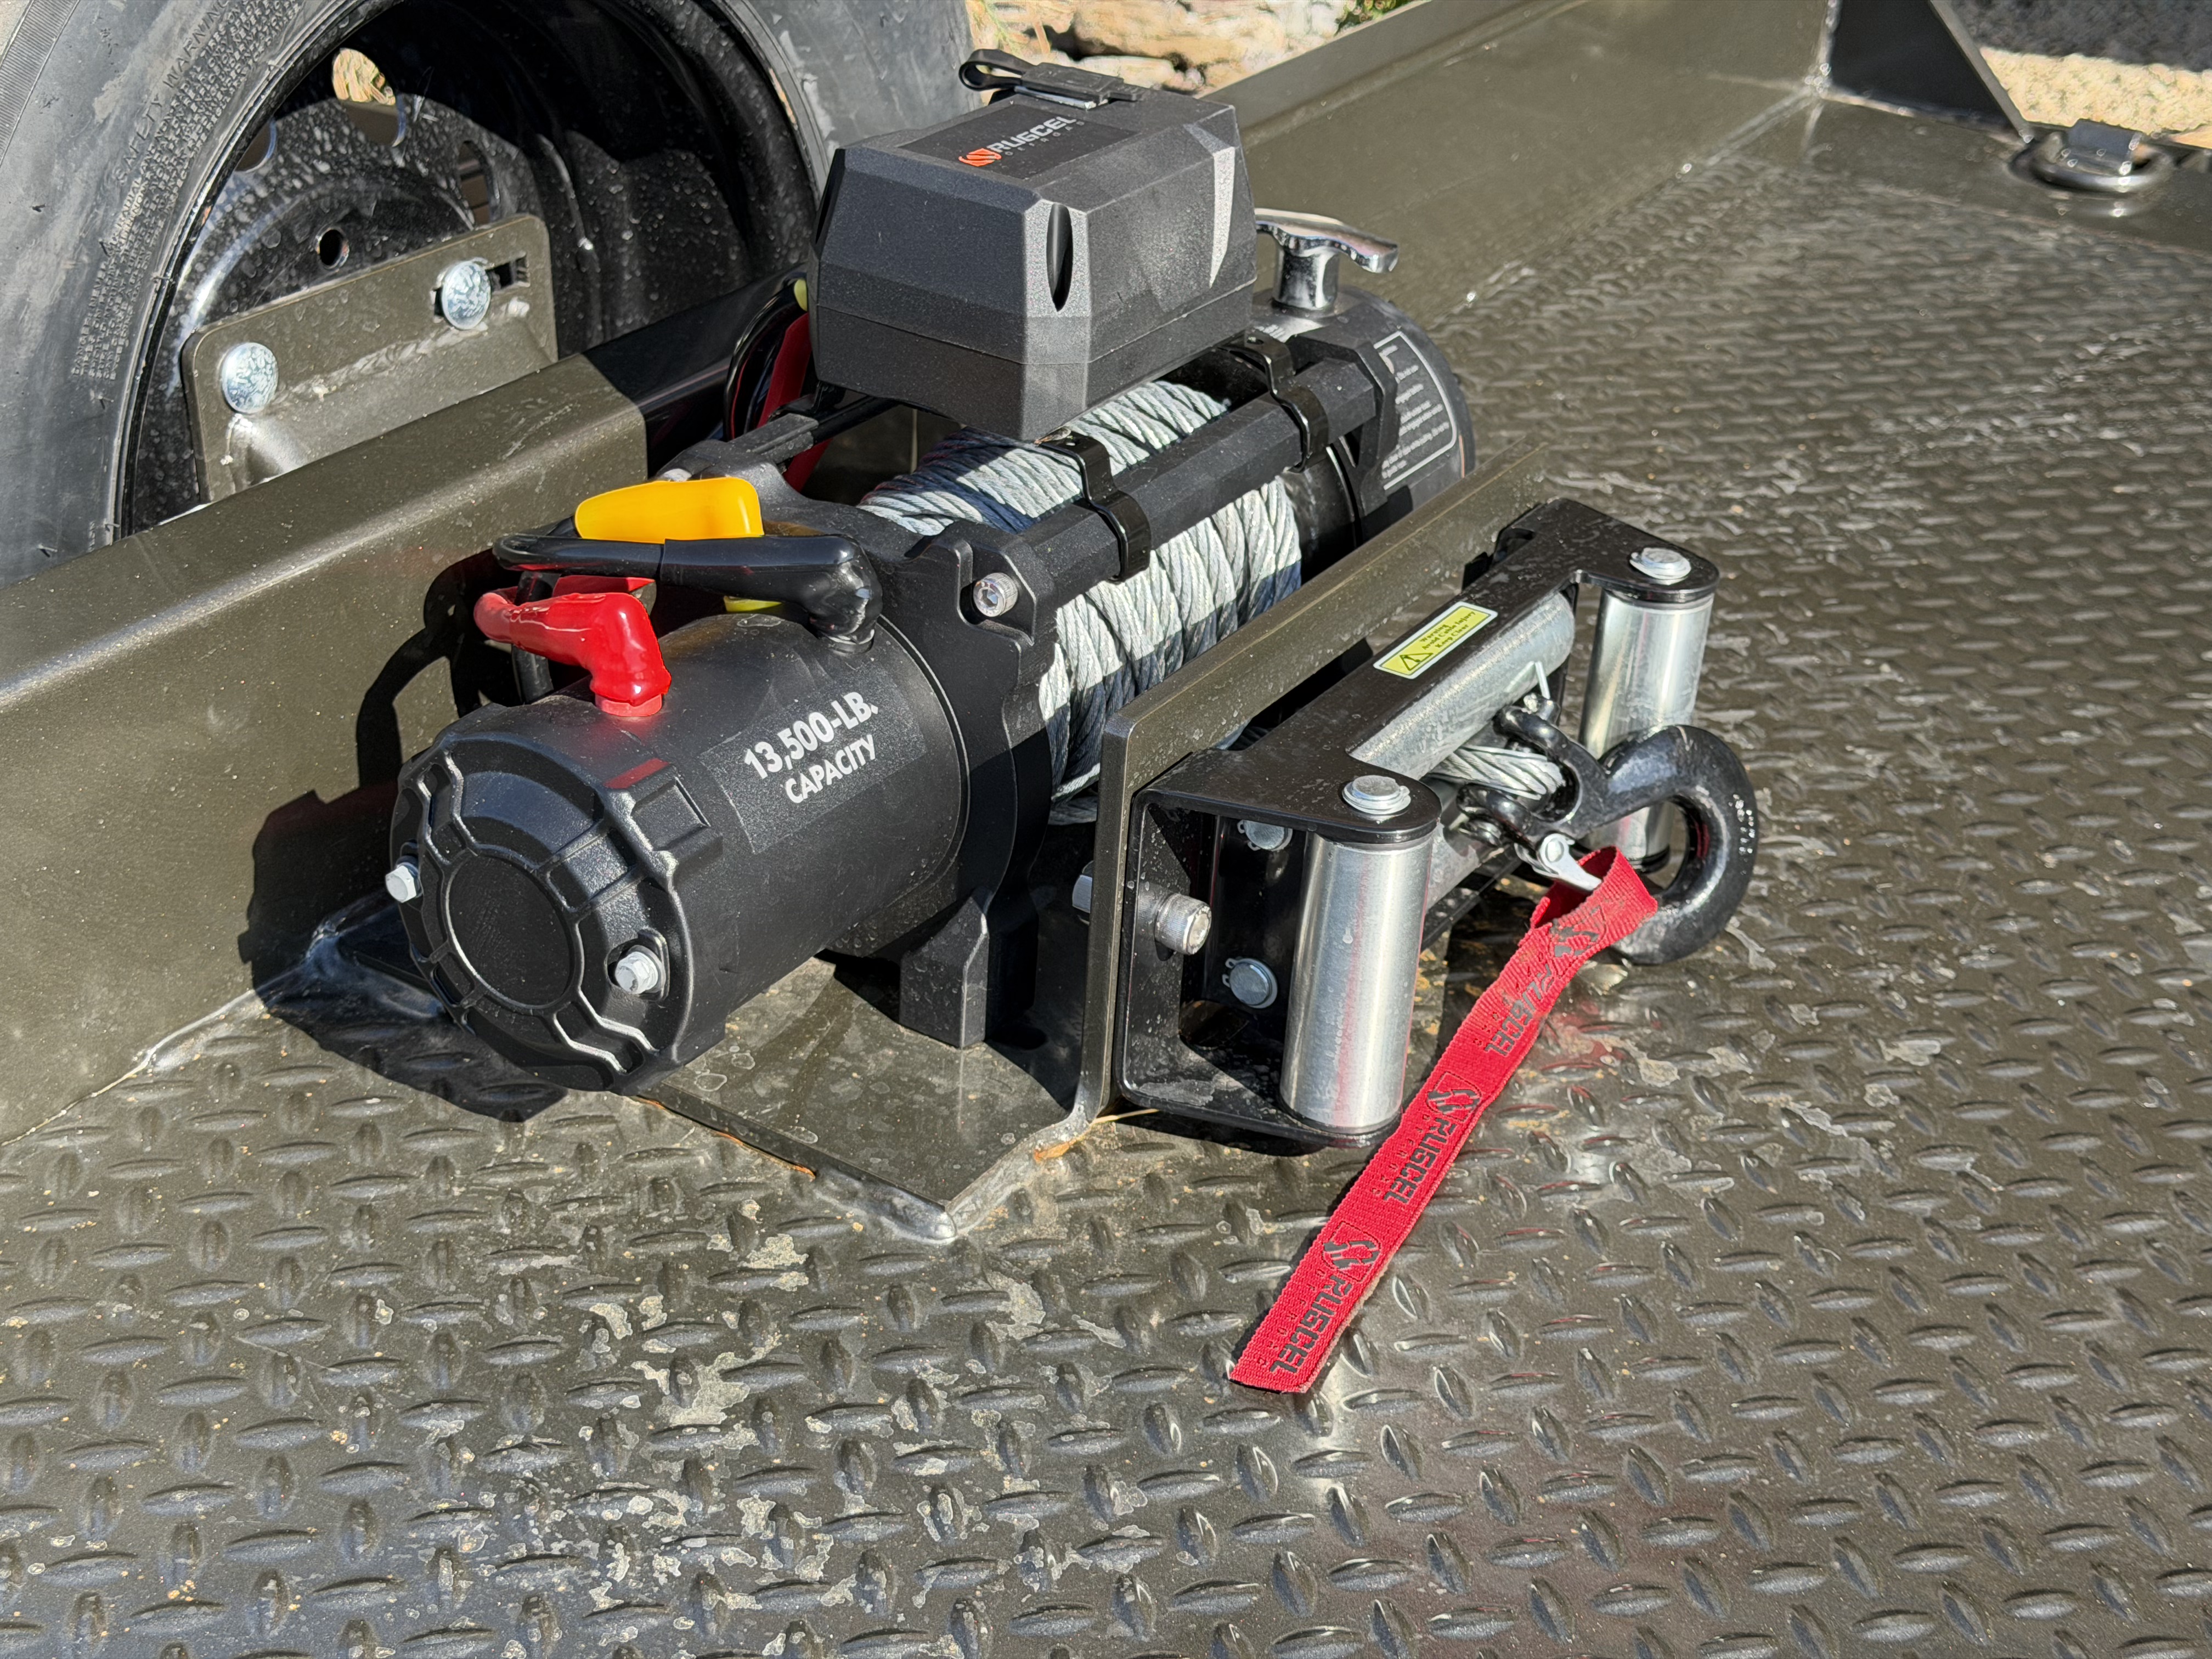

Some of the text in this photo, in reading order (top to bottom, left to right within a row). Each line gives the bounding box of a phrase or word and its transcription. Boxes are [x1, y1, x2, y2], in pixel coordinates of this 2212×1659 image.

[87, 260, 109, 308] NEVER
[114, 174, 141, 229] RADIAL
[136, 142, 156, 174] AND
[224, 5, 241, 24] ON
[91, 308, 103, 329] ON
[98, 257, 119, 304] FRONT
[170, 106, 187, 128] ON
[228, 0, 260, 36] SPECI
[103, 268, 123, 319] MOUNT
[137, 196, 151, 217] TO
[148, 154, 171, 194] AVOID
[233, 7, 263, 46] NEVER
[105, 317, 116, 338] TO
[111, 278, 128, 314] SEAT
[217, 0, 281, 82] UNDERINFLATIO
[114, 92, 167, 184] SAFETY
[140, 250, 153, 270] ON
[247, 44, 267, 67] FOR
[987, 116, 1076, 153] RUGCEL
[744, 692, 878, 779] 13,500-LB.
[785, 735, 875, 803] CAPACITY
[1485, 964, 1554, 1056] RUGCEL
[1384, 1118, 1457, 1204] RUGCEL
[1269, 1275, 1352, 1373] RUGCEL
